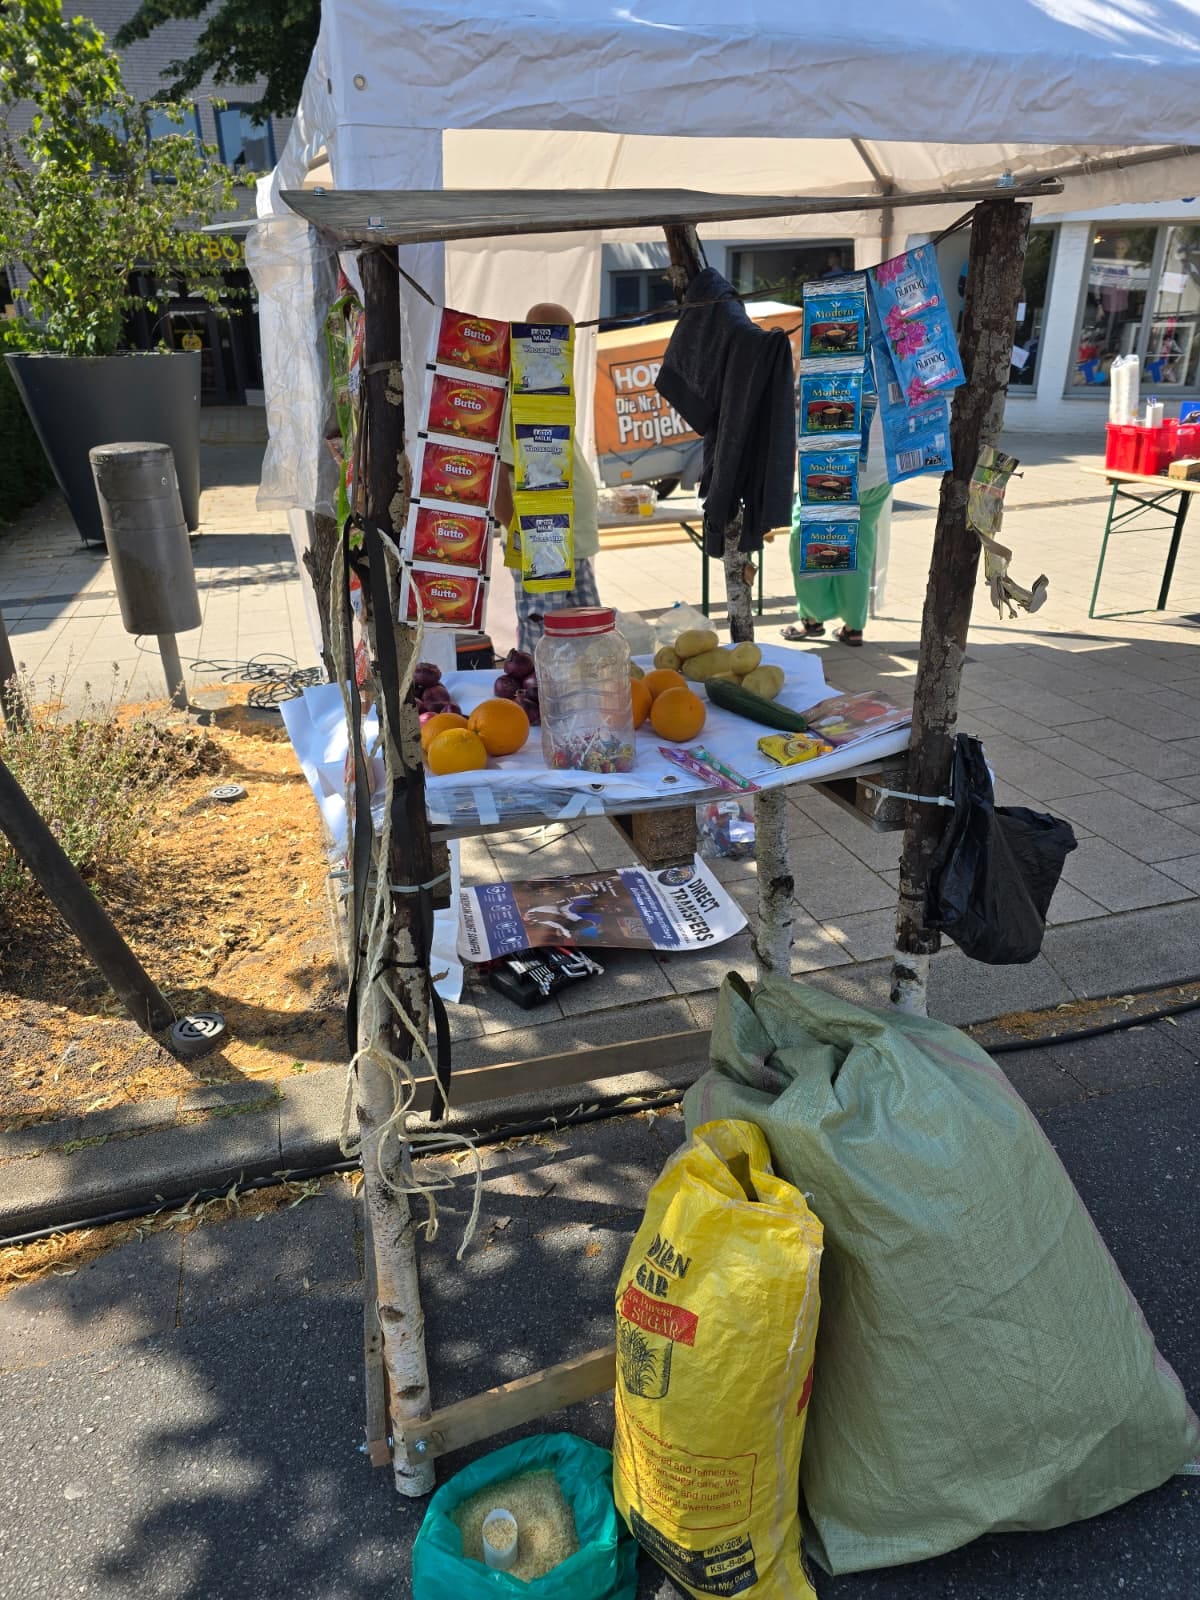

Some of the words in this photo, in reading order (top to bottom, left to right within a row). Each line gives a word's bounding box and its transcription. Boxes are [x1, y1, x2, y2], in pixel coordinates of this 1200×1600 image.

[463, 327, 491, 342] Butto
[454, 397, 482, 410] Butto
[616, 397, 637, 414] Die
[445, 463, 473, 476] Butto
[437, 527, 464, 539] Butto
[431, 588, 457, 599] Butto
[688, 878, 720, 913] DIRECT
[670, 888, 714, 942] TRANSFERS
[632, 1306, 680, 1339] SUGAR
[674, 1462, 692, 1474] and
[680, 1489, 699, 1500] and
